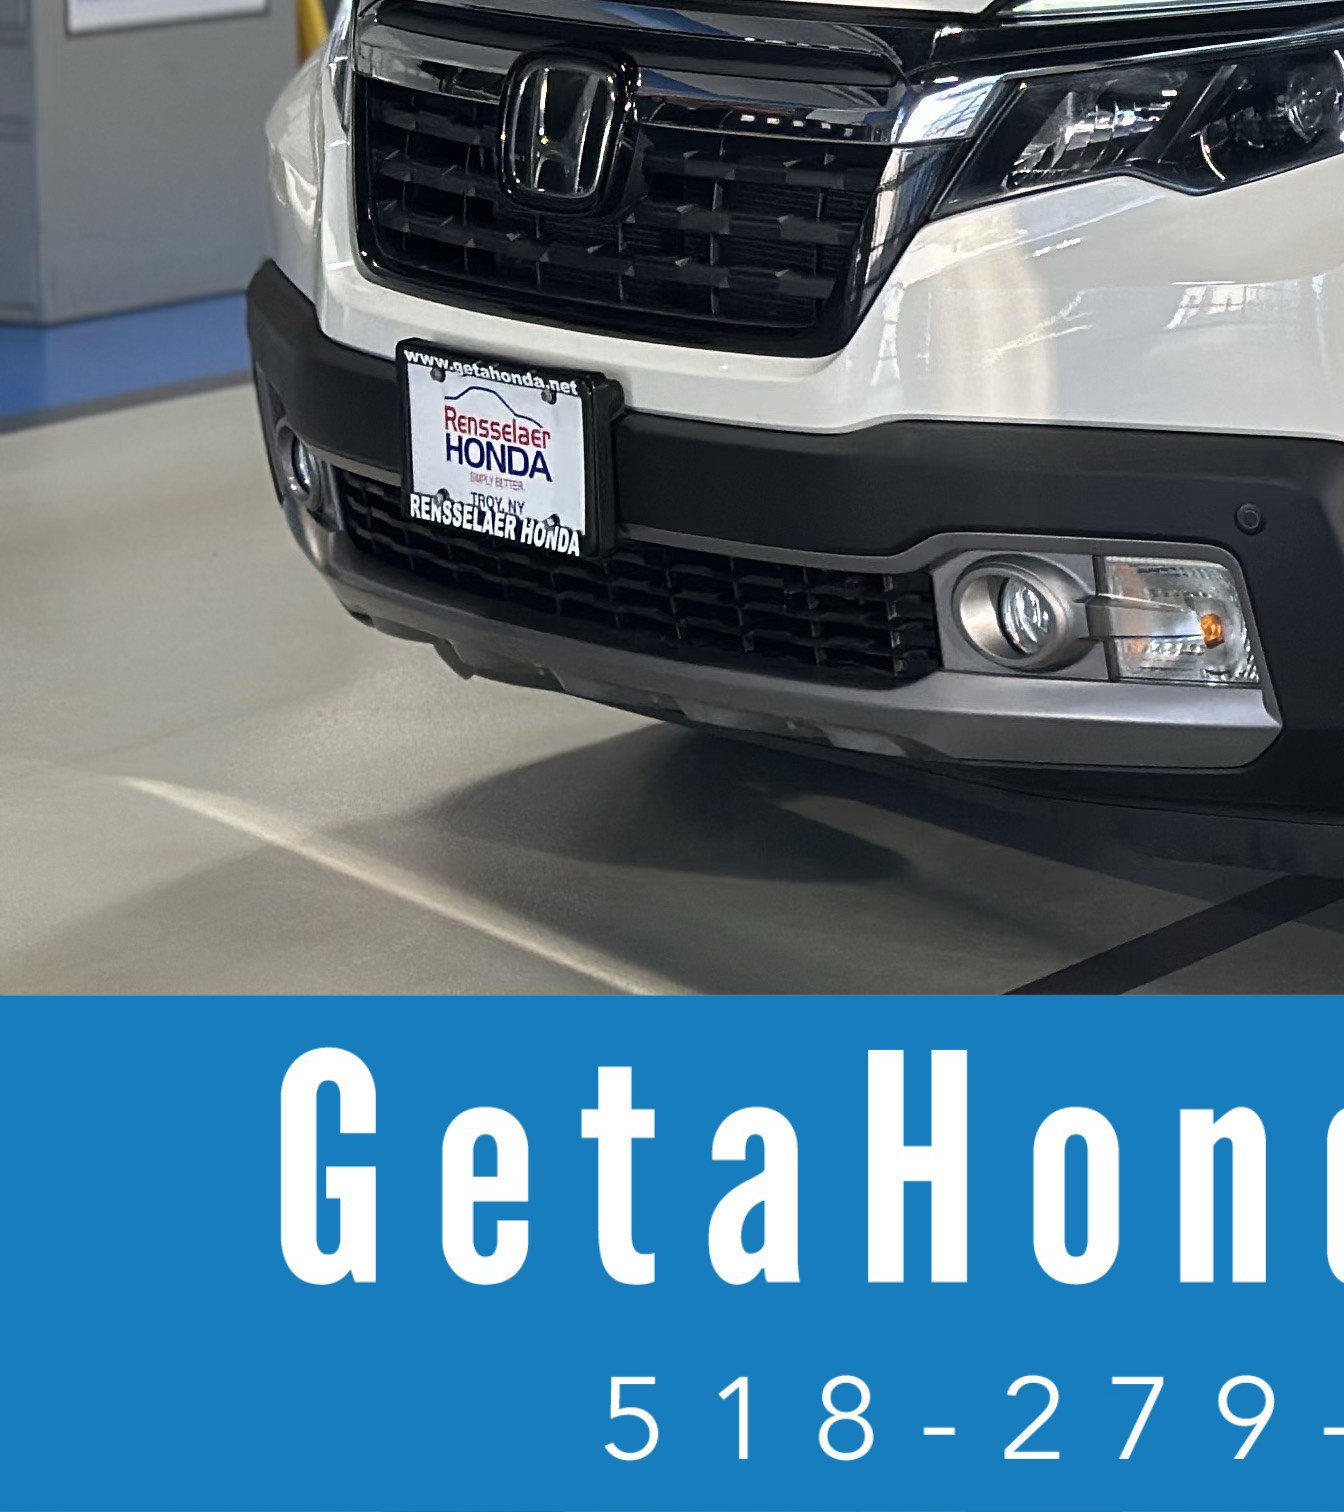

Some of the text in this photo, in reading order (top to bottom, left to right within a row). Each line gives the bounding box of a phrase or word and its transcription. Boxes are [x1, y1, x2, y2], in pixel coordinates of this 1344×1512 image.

[403, 349, 578, 396] www.getahonda.net
[444, 404, 551, 449] Rensselaer
[445, 433, 553, 483] HONDA
[410, 493, 580, 557] RENSSELAER HONDA
[508, 498, 525, 515] NY
